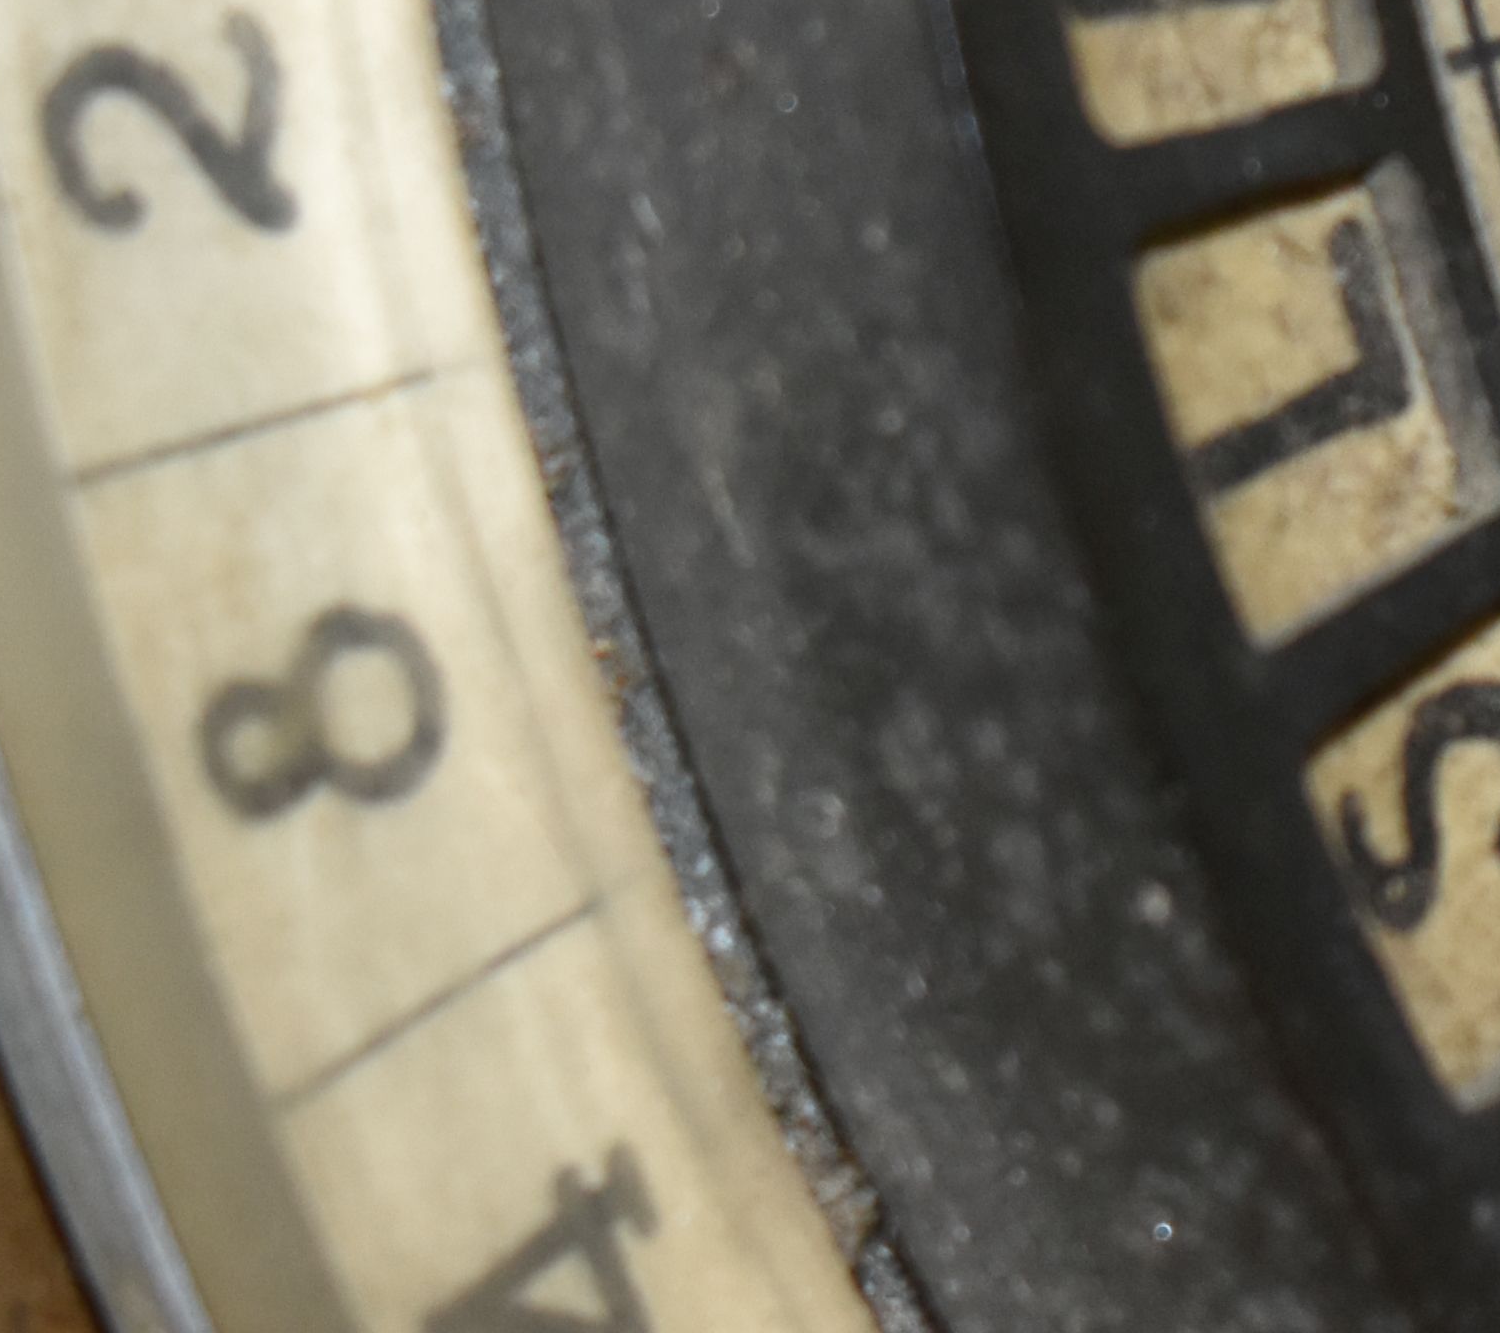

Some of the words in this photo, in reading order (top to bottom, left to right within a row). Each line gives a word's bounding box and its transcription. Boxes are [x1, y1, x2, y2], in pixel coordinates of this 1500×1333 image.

[36, 7, 300, 238] 2
[1185, 217, 1414, 493] L
[198, 599, 451, 825] 8
